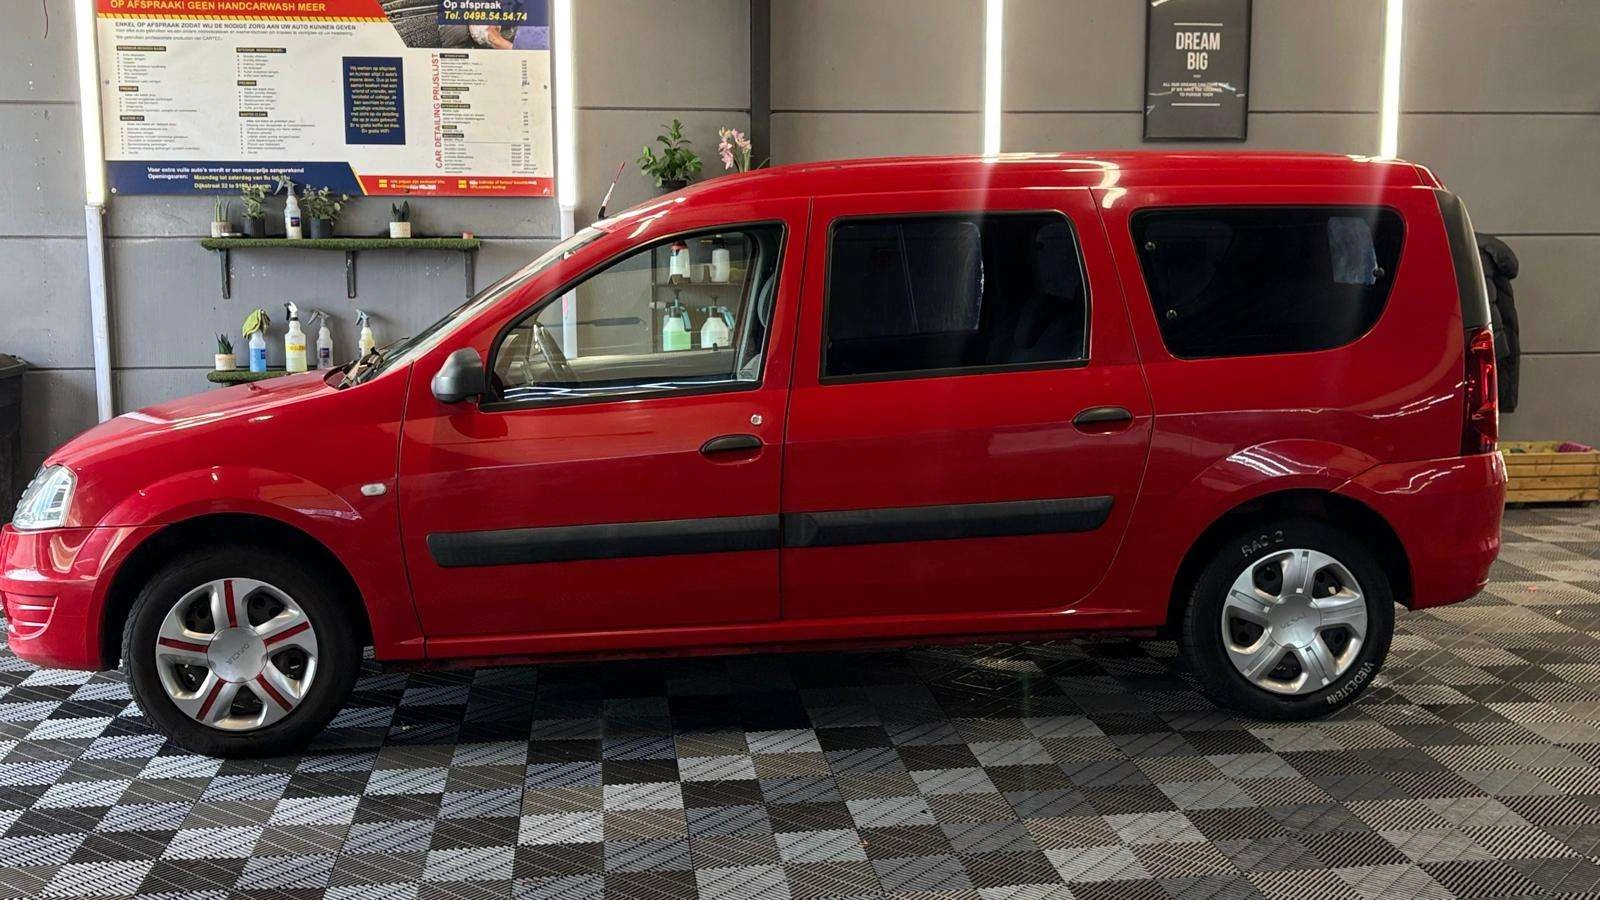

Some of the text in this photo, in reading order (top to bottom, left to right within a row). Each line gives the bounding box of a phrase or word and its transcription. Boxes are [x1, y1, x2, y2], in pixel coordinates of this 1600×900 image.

[111, 1, 326, 12] OP AFSPRAAK! GEEN HANDCARWASH MEER
[443, 0, 502, 10] Op afspraak
[445, 11, 528, 21] Tel. 0498.54.54.74
[1175, 32, 1220, 50] DREAM
[1187, 52, 1208, 70] BIG
[431, 53, 443, 168] CAR DETAILING PRIJSLIJST
[1275, 530, 1285, 544] 2
